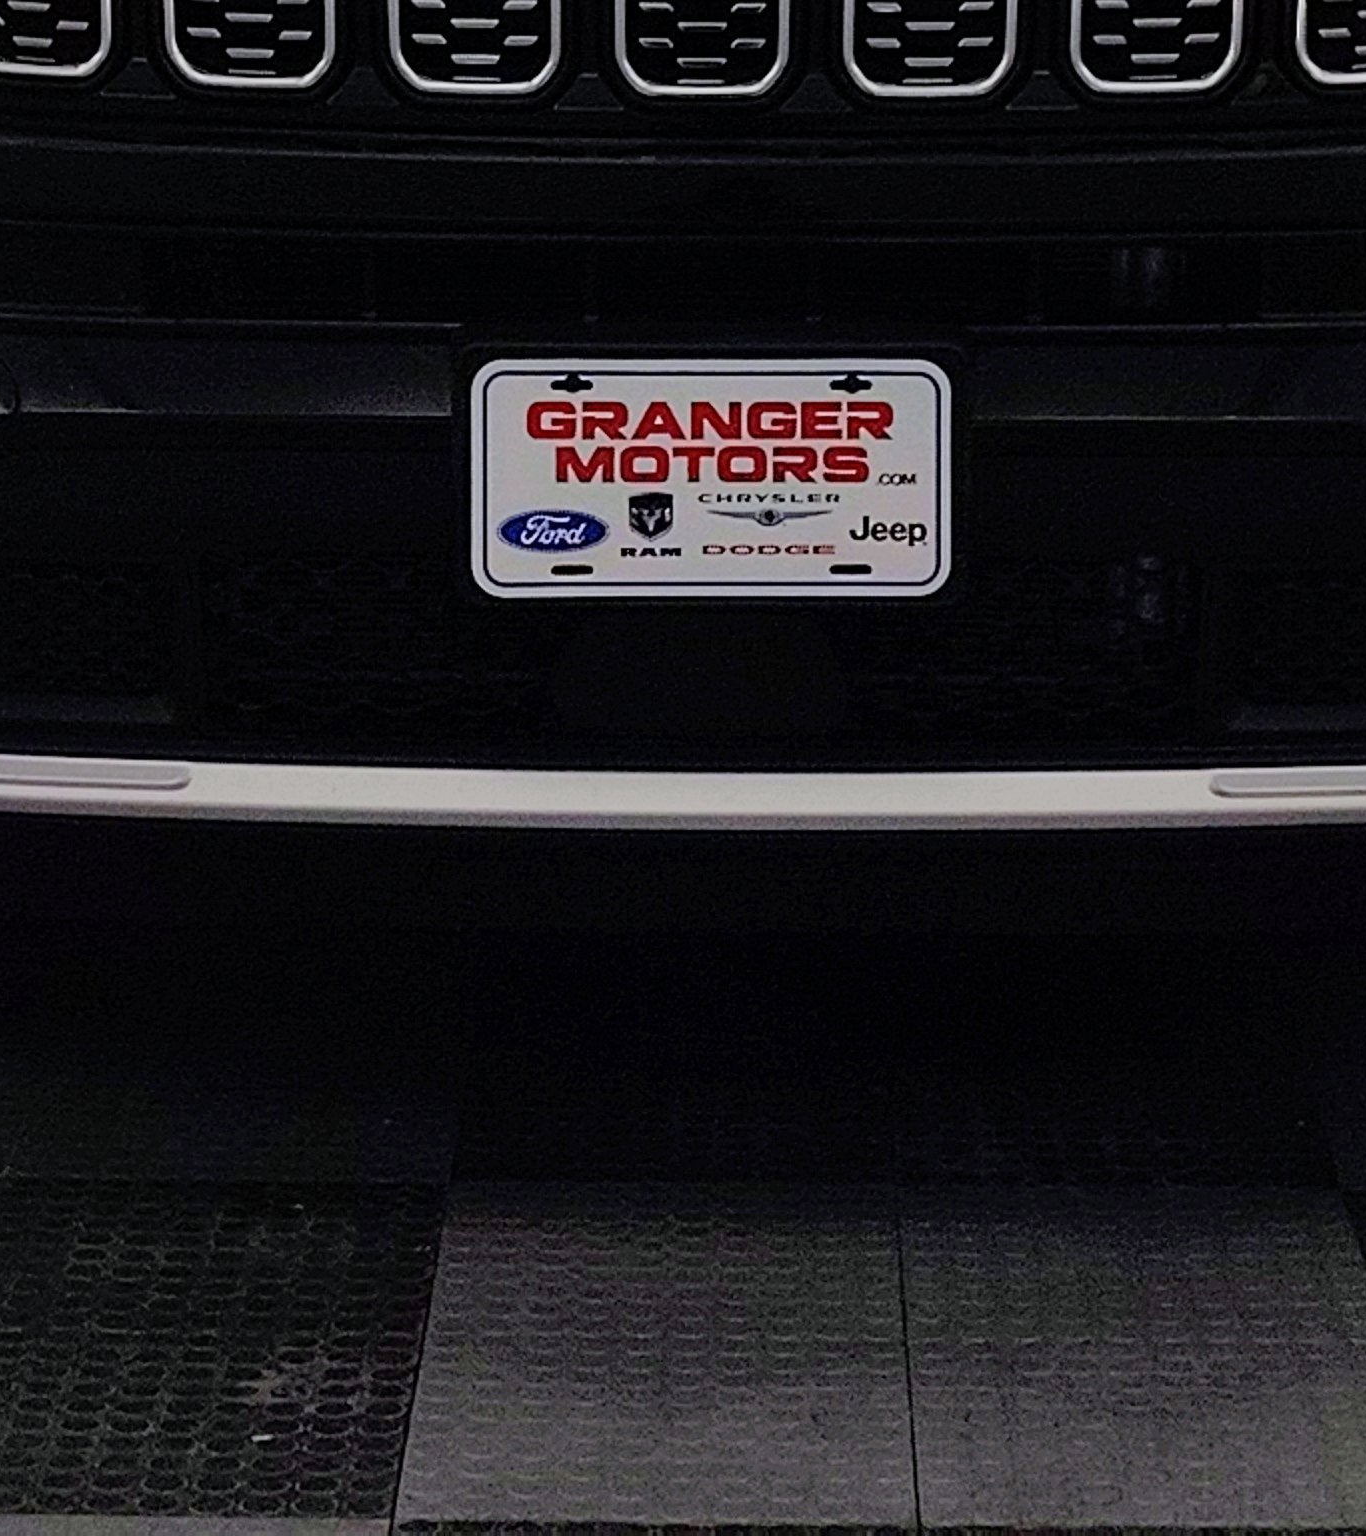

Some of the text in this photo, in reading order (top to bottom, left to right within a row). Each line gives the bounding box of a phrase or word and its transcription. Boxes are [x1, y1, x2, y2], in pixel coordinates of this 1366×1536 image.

[526, 401, 894, 440] GRANGER
[555, 446, 870, 483] MOTORS
[698, 493, 841, 503] CHRYSLER
[520, 515, 587, 545] Ford
[848, 515, 928, 547] Jeep
[620, 547, 682, 557] RAM
[702, 544, 836, 555] DODGE
